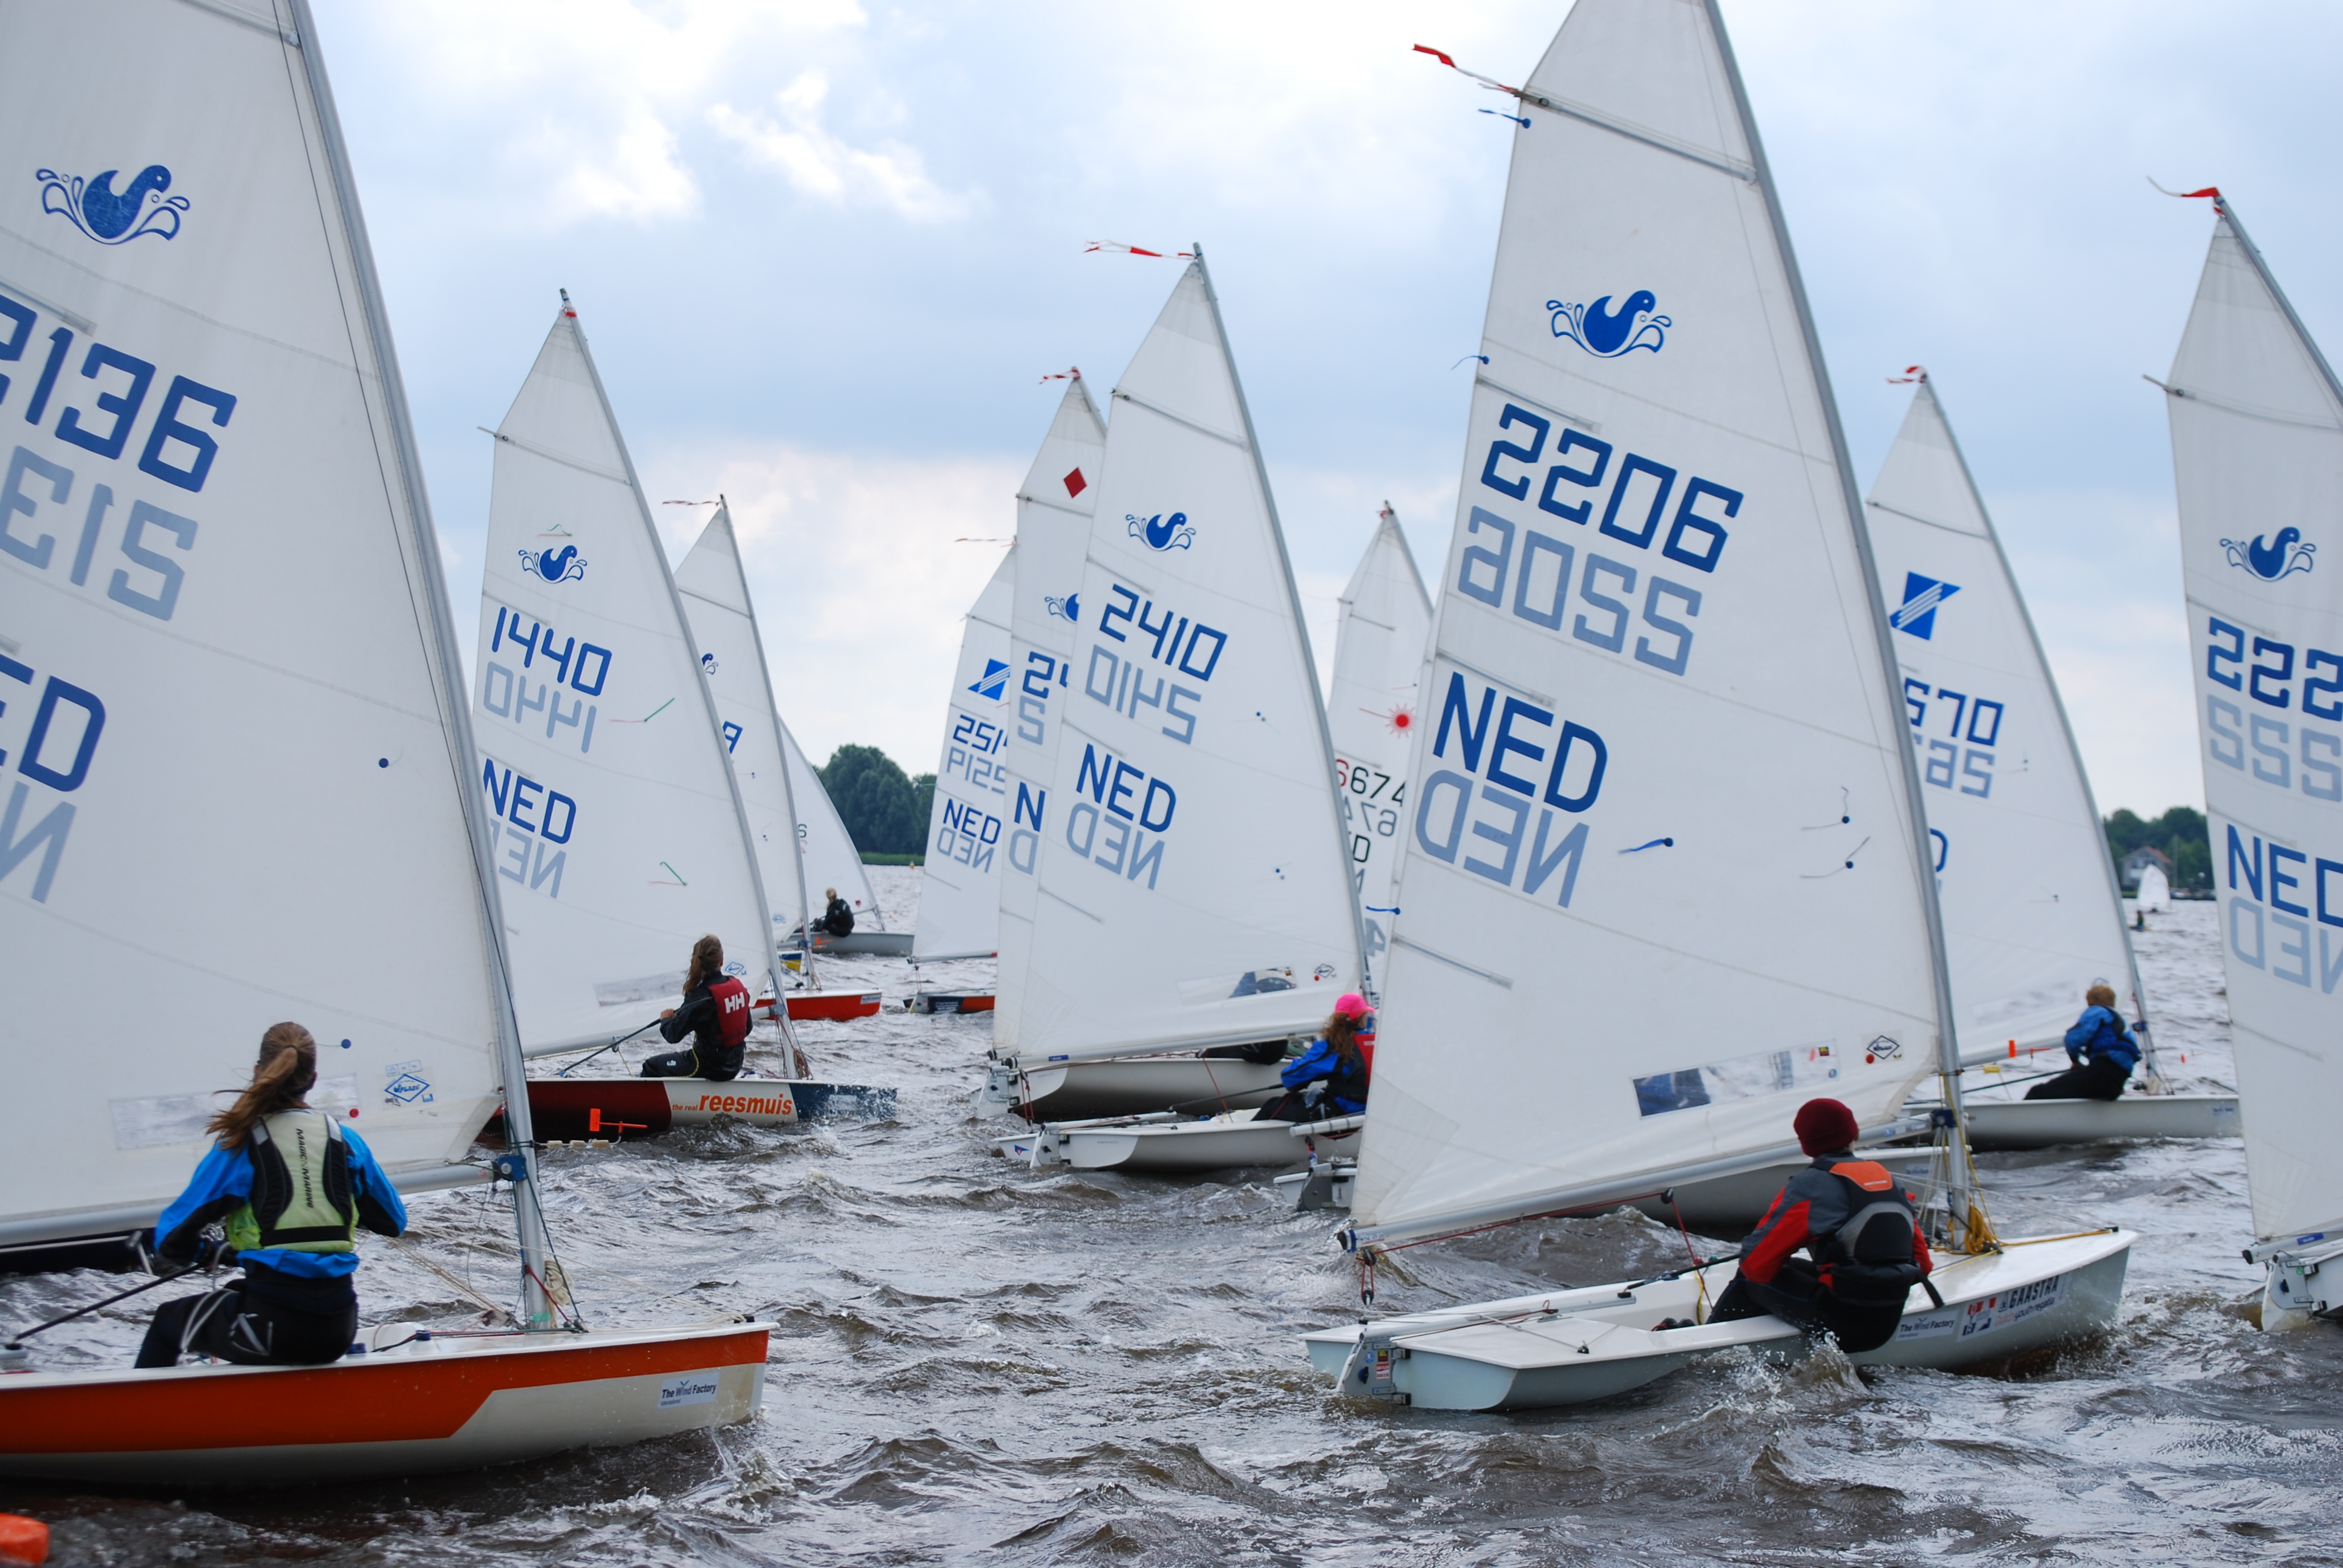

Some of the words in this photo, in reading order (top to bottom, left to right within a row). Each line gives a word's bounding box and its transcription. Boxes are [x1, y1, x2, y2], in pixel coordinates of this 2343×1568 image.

[1481, 403, 1744, 573] 2206
[492, 606, 612, 697] 1440
[1099, 583, 1228, 682] 2410
[952, 714, 1008, 755] 251
[1432, 671, 1608, 813] NED
[482, 757, 577, 844] NED
[1076, 742, 1176, 833] NED
[943, 798, 1002, 844] NED
[724, 991, 746, 1014] HH
[698, 1093, 793, 1116] reesmuis
[296, 1128, 308, 1161] MAGIC
[2009, 1274, 2059, 1309] GAASTRA
[1901, 1324, 1913, 1332] The
[1930, 1319, 1955, 1328] Factory
[662, 1388, 675, 1399] The
[676, 1385, 692, 1397] Wind
[692, 1383, 717, 1394] Factory
